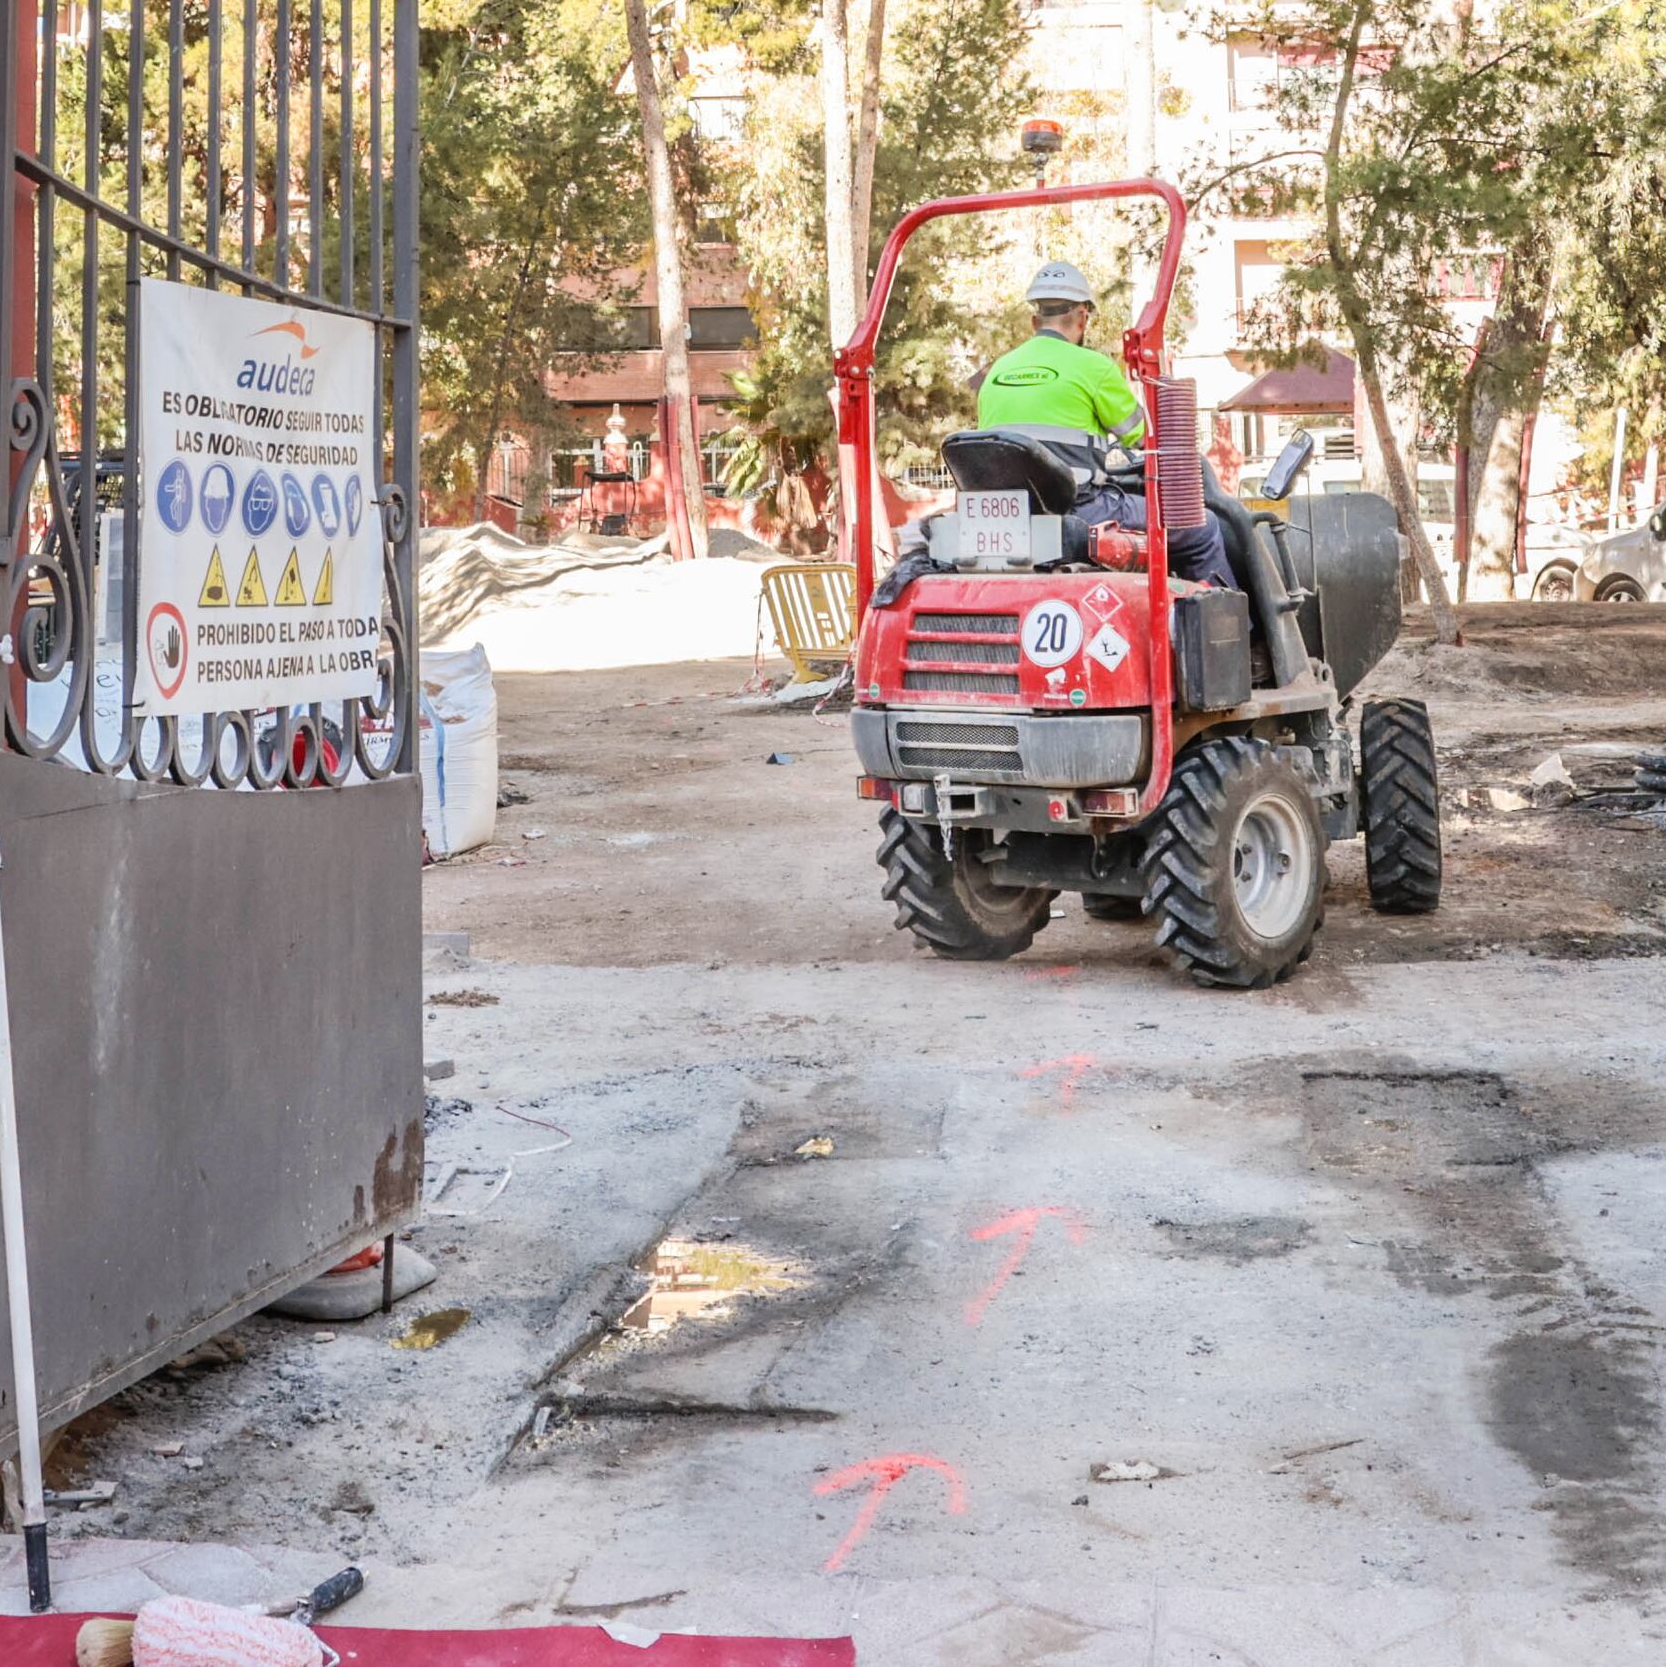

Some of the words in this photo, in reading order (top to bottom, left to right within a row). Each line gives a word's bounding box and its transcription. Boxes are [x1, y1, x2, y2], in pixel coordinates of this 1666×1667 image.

[236, 353, 316, 396] audeca
[162, 391, 182, 414] ES
[185, 394, 284, 429] OBLIGATORIO
[285, 410, 322, 431] SEGUIR
[326, 413, 365, 434] TODAS
[176, 429, 203, 453] LAS
[207, 432, 263, 461] NORMAS
[266, 443, 284, 464] DE
[286, 443, 358, 465] SEGURIDAD
[966, 497, 976, 518] E
[981, 497, 1020, 518] 6806
[197, 622, 276, 646] PROHIBIDO
[279, 621, 295, 643] EL
[298, 620, 325, 642] PASO
[327, 620, 334, 639] A
[337, 616, 379, 639] TODA
[1034, 612, 1068, 653] 20
[197, 658, 264, 683] PERSONA
[266, 655, 304, 679] AJENA
[306, 655, 314, 675] A
[319, 652, 336, 674] LA
